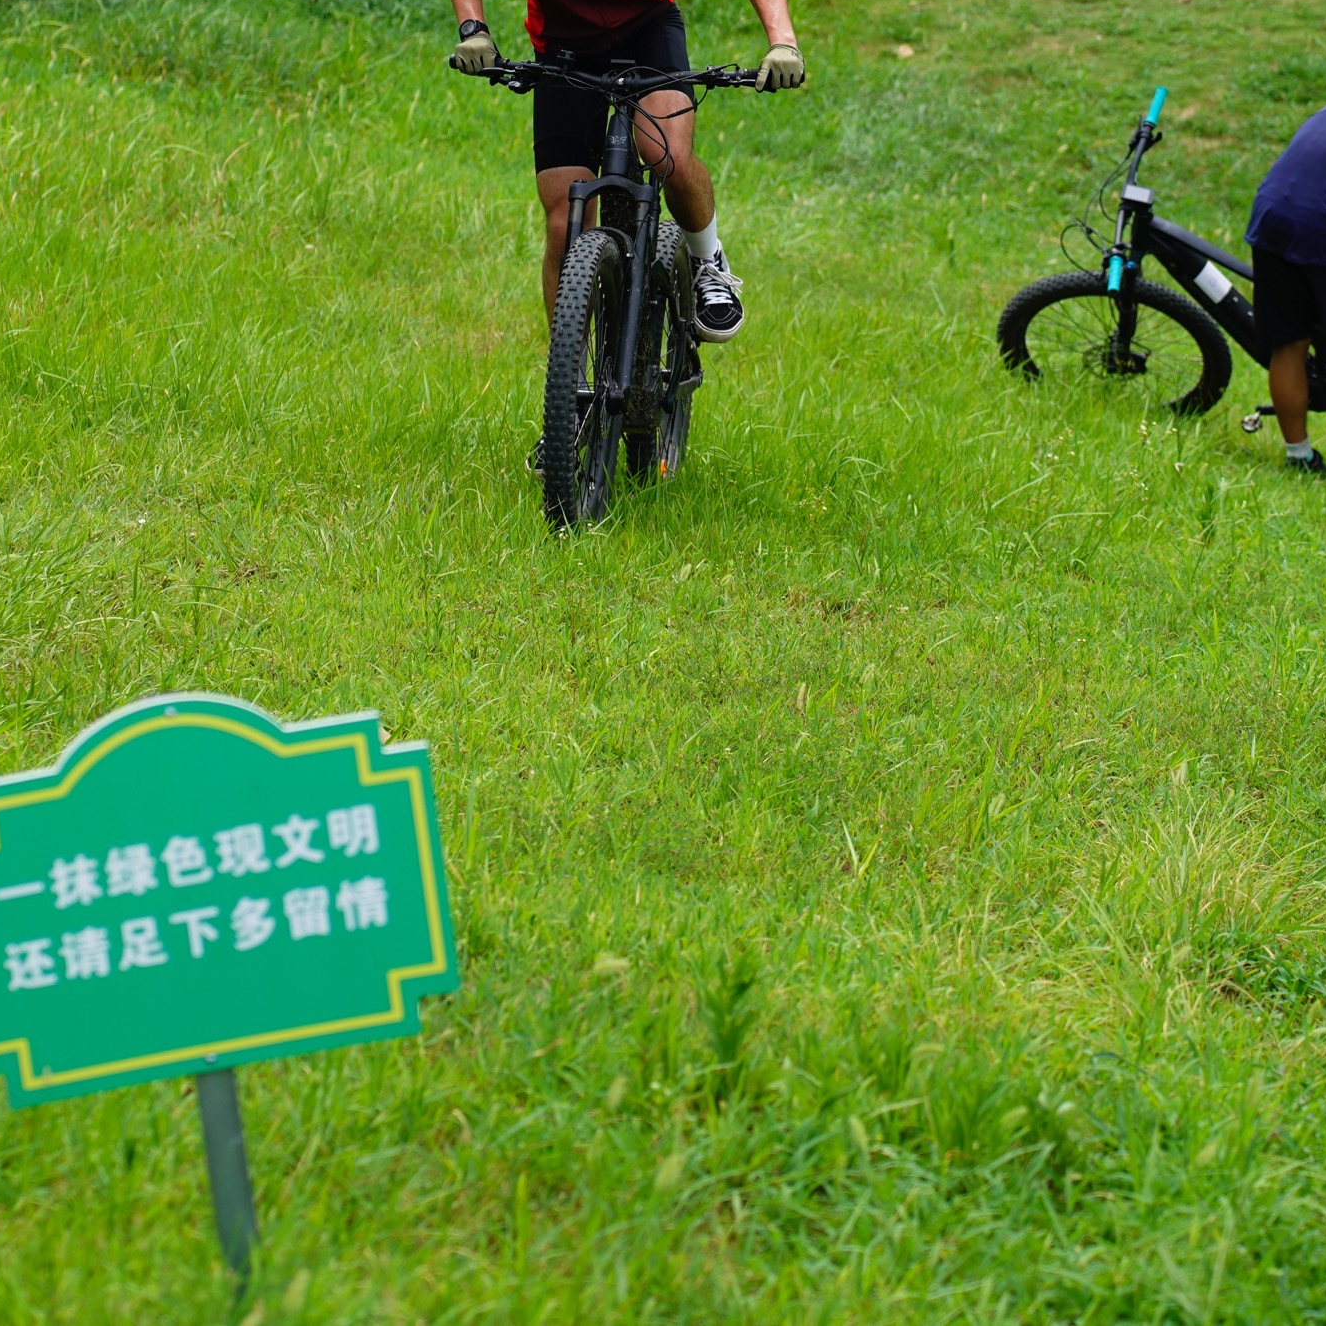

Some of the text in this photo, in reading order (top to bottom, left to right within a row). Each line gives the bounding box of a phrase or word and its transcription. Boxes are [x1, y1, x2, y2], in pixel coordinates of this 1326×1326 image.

[3, 876, 390, 992] 还请足下多留情
